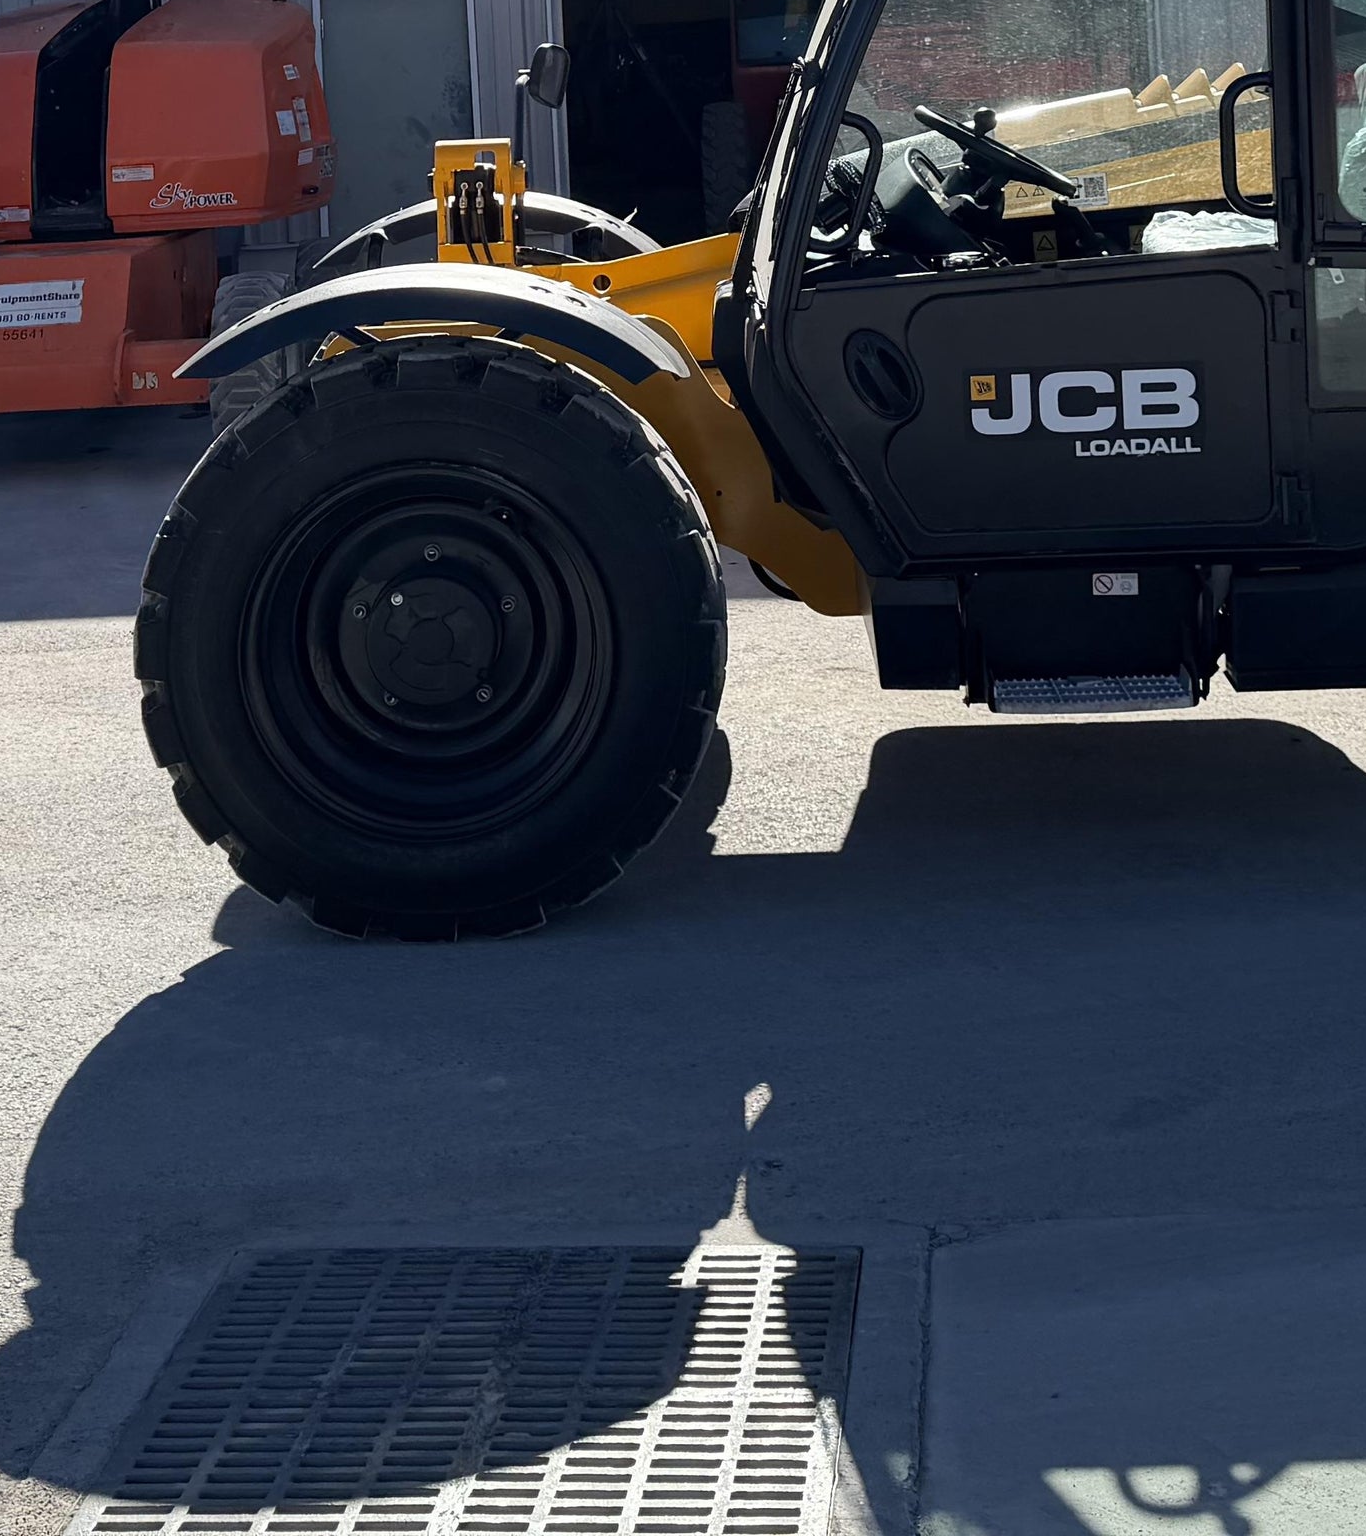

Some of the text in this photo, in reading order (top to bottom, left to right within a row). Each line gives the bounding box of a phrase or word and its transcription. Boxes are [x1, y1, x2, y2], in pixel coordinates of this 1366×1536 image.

[3, 329, 44, 341] 55641
[971, 368, 1199, 435] JCB
[1075, 437, 1201, 457] LOADALL
